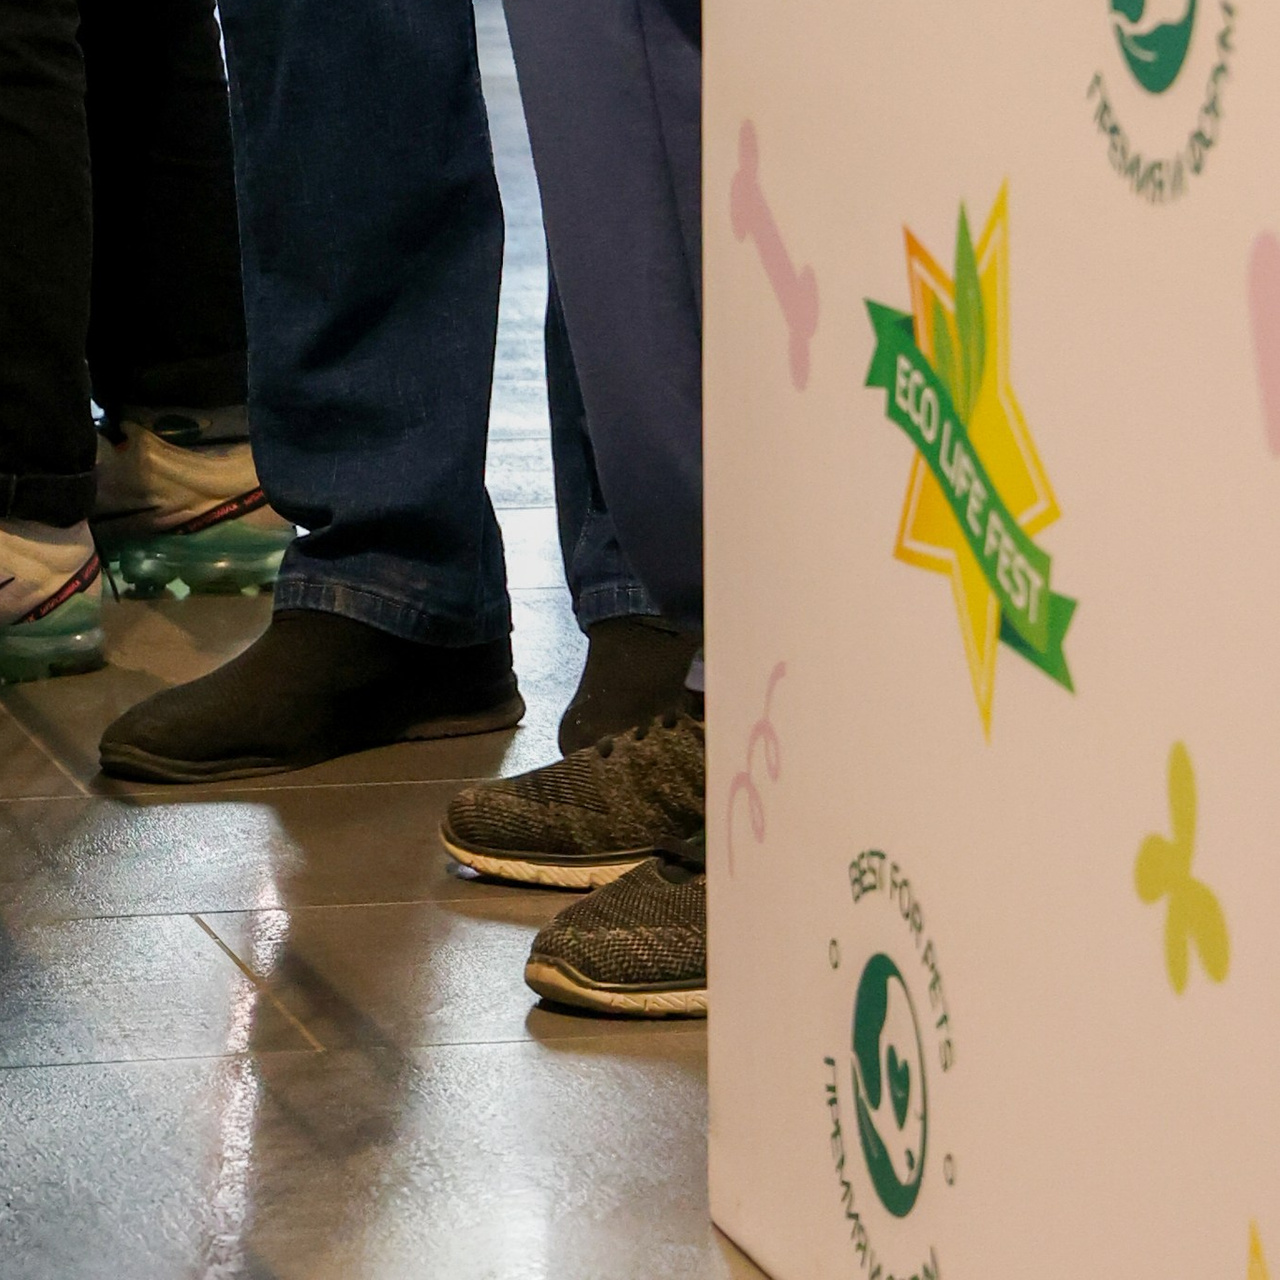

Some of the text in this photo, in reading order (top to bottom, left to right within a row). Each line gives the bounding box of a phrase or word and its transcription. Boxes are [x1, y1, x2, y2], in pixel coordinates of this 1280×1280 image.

[895, 353, 1045, 625] ECO LIFE FEST
[848, 849, 953, 1072] BEST FOR PETS
